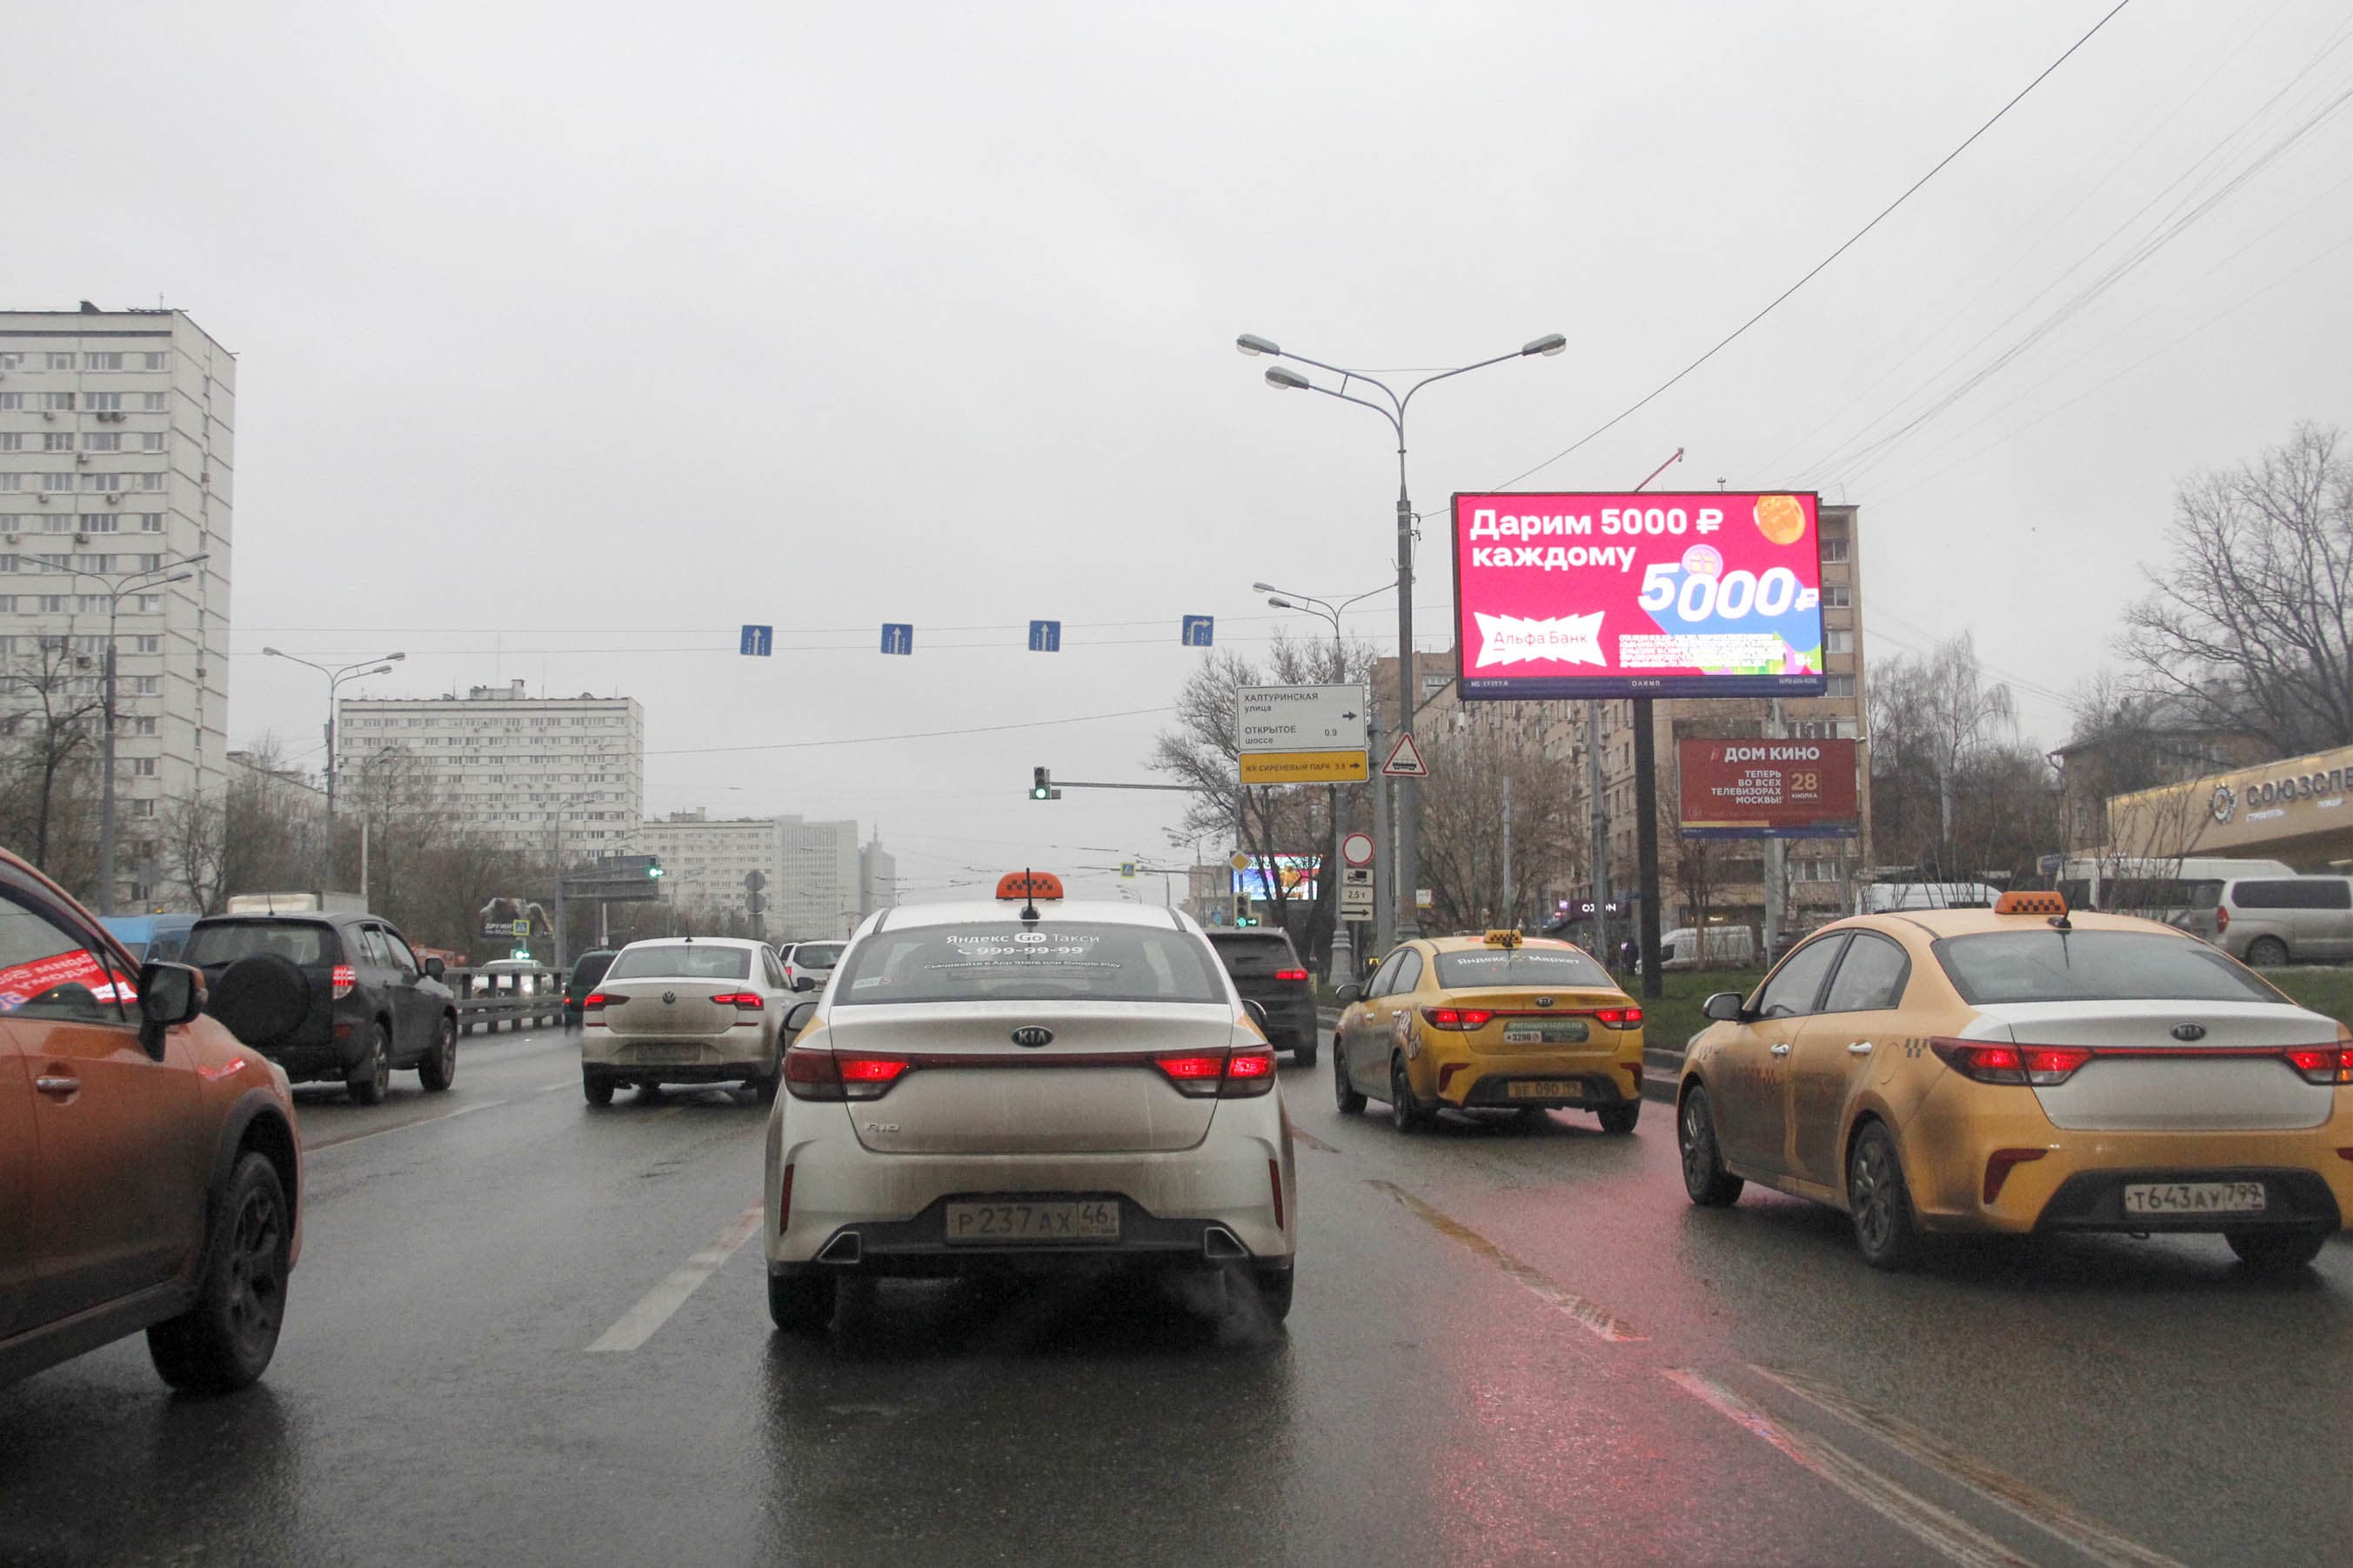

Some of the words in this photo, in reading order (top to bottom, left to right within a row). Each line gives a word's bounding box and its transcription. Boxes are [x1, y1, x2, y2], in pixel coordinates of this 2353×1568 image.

[1469, 509, 1592, 541] Дарим
[1601, 508, 1687, 535] 5000
[1472, 545, 1636, 572] каждому
[1494, 631, 1546, 651] Альфа
[1549, 631, 1588, 644] Банк
[1244, 692, 1319, 702] ХАЛТУРИНСКАЯ
[1244, 704, 1272, 713] улица
[1245, 725, 1296, 734] ОТКРЫТОЕ
[1724, 747, 1766, 763] ДОМ
[1769, 747, 1821, 760] КИНО
[1790, 773, 1818, 791] 28
[946, 935, 1010, 944] Яндекс
[1051, 933, 1100, 943] Такси
[976, 946, 1084, 955] 999-99-99
[1457, 956, 1507, 964] Яндекс
[1528, 956, 1580, 964] Маркет
[1019, 1030, 1047, 1044] KIA
[2176, 1025, 2202, 1039] KIA
